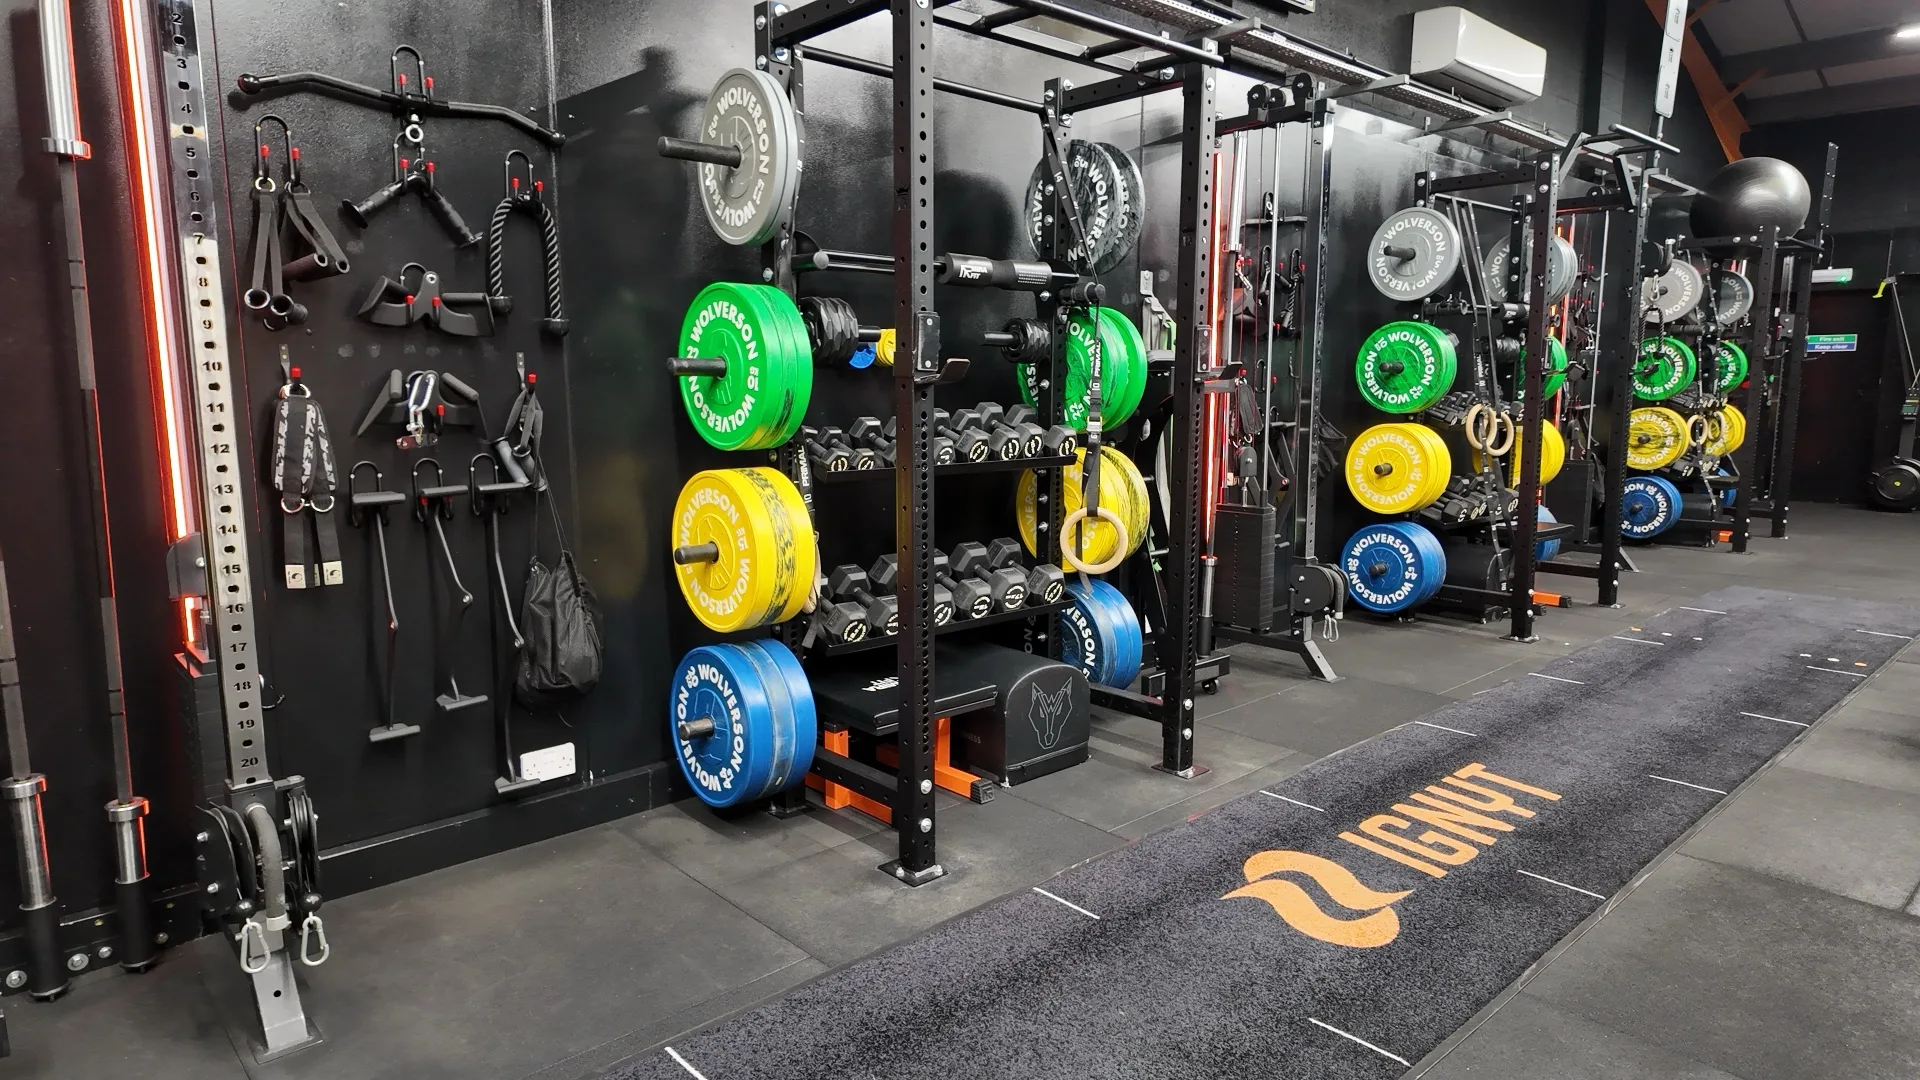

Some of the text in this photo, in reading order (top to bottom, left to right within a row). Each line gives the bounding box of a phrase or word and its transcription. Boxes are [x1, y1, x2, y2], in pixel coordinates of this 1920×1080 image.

[172, 13, 182, 24] 2
[178, 59, 187, 68] 3
[181, 104, 192, 114] 4
[716, 86, 769, 174] WOLVERSON
[186, 148, 196, 157] 5
[190, 192, 200, 201] 6
[705, 163, 756, 227] WOLVERSO
[194, 235, 204, 244] 7
[1384, 217, 1446, 252] WOLVERSON
[198, 278, 208, 286] 8
[1666, 268, 1692, 316] WOLVERSON
[202, 320, 212, 330] 9
[690, 300, 758, 360] WOLVERSON
[1388, 331, 1435, 386] WOLVERSON
[202, 362, 222, 372] 10
[1364, 350, 1410, 404] WOLVERSON
[206, 403, 224, 412] 11
[688, 375, 756, 432] WOLVERSON
[1630, 414, 1672, 434] OLVERSON
[210, 444, 230, 454] 12
[1358, 433, 1421, 464] WOLVERSON
[1628, 447, 1670, 464] WOLVERS
[798, 445, 810, 486] PRIMAL
[214, 484, 234, 494] 13
[1354, 473, 1416, 504] WOLVERSON
[804, 494, 812, 504] 10
[1633, 492, 1668, 533] WOLVERSON
[218, 524, 238, 534] 14
[1351, 533, 1416, 564] WOLVERSON
[222, 564, 242, 574] 15
[1348, 558, 1359, 566] 20
[690, 558, 750, 616] WOLVERSON
[1350, 572, 1414, 604] WOLVERSON
[225, 604, 244, 614] 16
[1062, 606, 1096, 667] VERSON
[230, 642, 248, 652] 17
[233, 681, 252, 690] 18
[237, 720, 255, 729] 19
[698, 664, 744, 772] WOLVERSON
[678, 686, 722, 792] WOLVEON
[240, 757, 258, 768] 20
[1337, 761, 1563, 879] IGNYT
